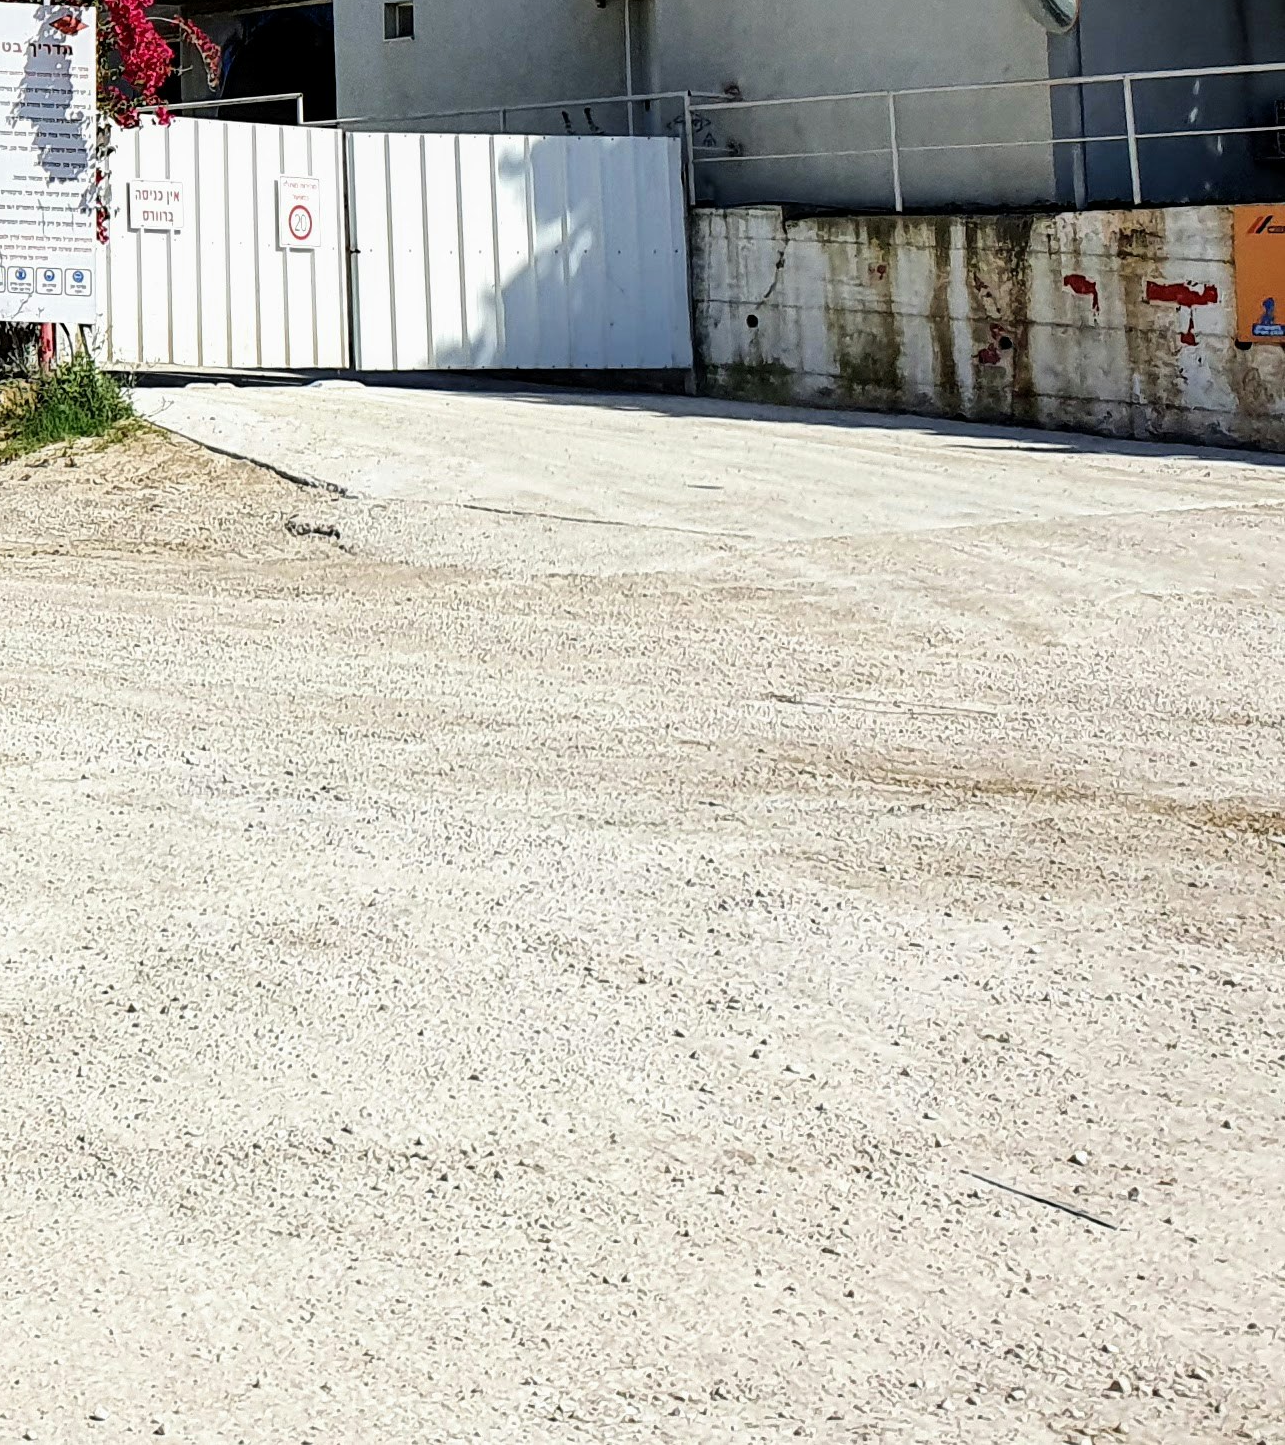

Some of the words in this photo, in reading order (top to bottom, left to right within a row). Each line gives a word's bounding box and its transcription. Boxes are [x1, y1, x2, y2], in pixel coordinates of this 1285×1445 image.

[135, 189, 163, 201] כניסה
[167, 190, 180, 205] אין
[142, 210, 173, 222] ברוורס
[295, 213, 307, 232] 20
